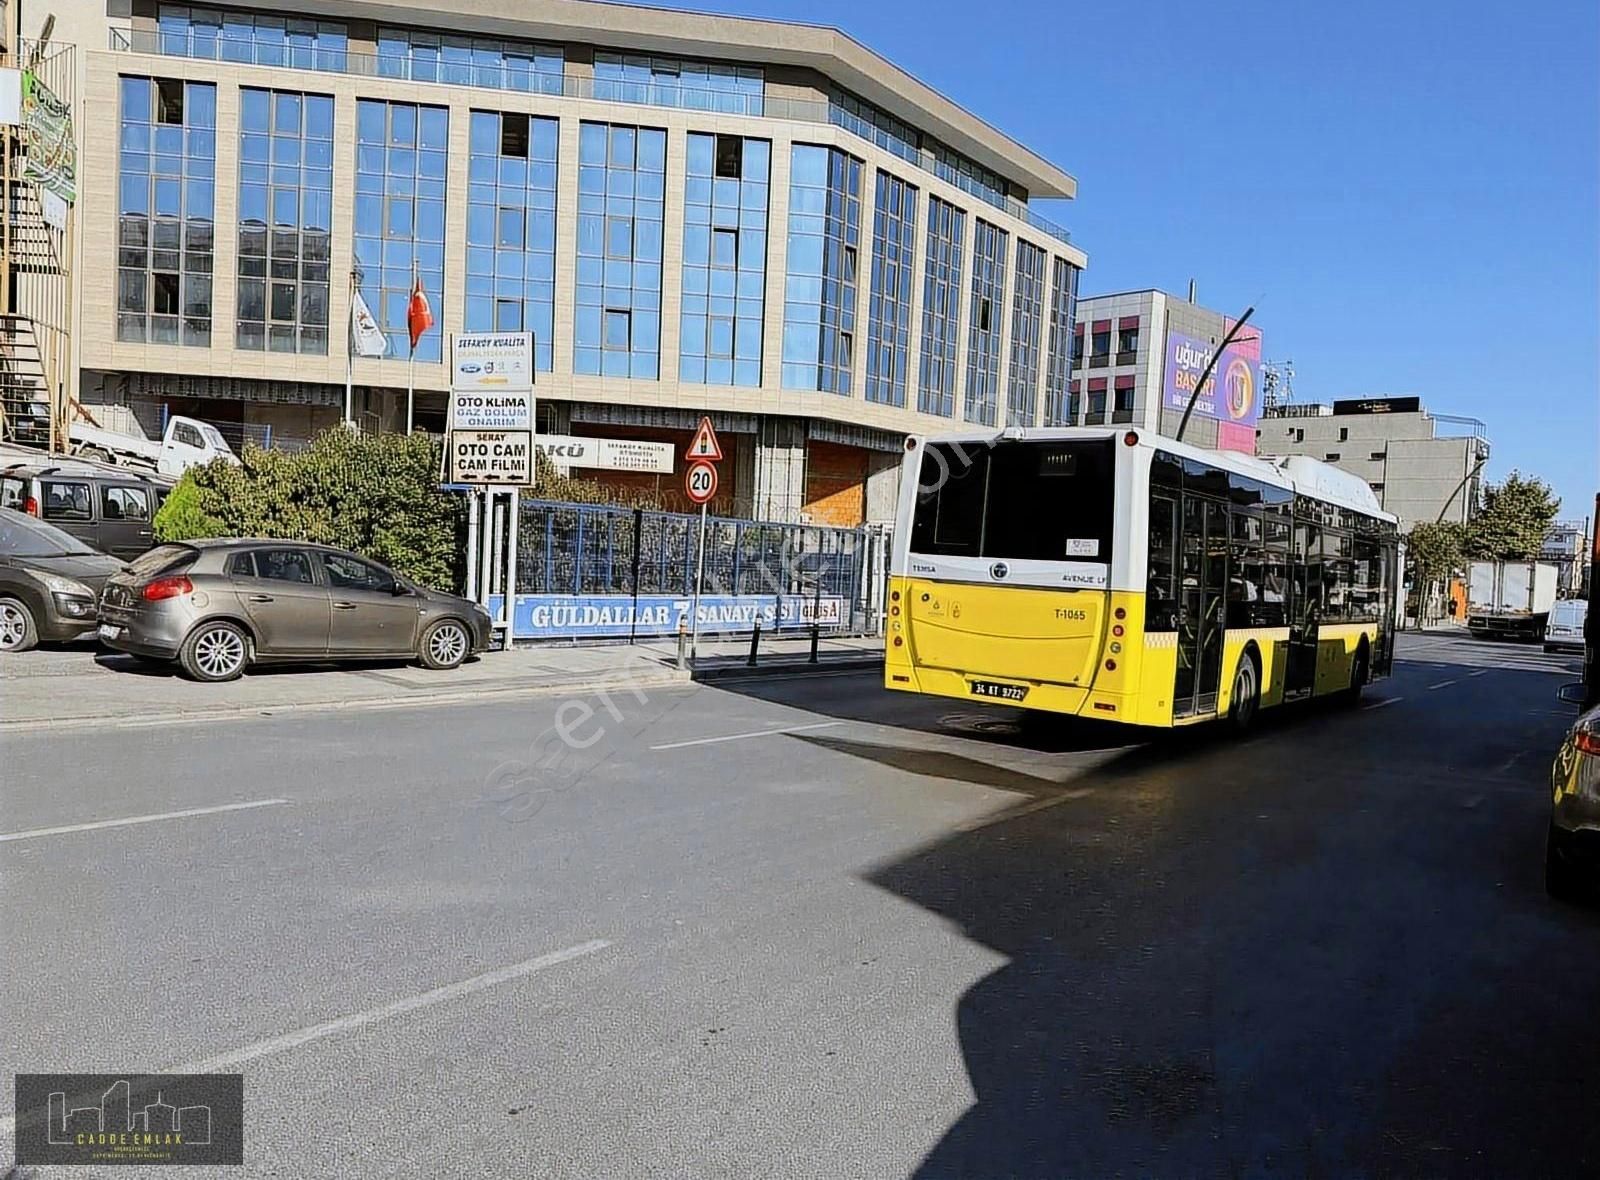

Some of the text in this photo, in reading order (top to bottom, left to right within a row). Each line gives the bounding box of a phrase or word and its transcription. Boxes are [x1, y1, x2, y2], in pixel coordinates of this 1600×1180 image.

[457, 397, 483, 407] OTO
[457, 408, 527, 417] GAZ DOLUM
[468, 418, 515, 426] ONARIM
[476, 433, 506, 442] SERAY
[458, 444, 526, 457] OTO CAM
[458, 459, 487, 470] CAM
[692, 472, 710, 490] 20
[532, 600, 671, 627] GÜLDALLAR
[1055, 608, 1086, 621] T-1065
